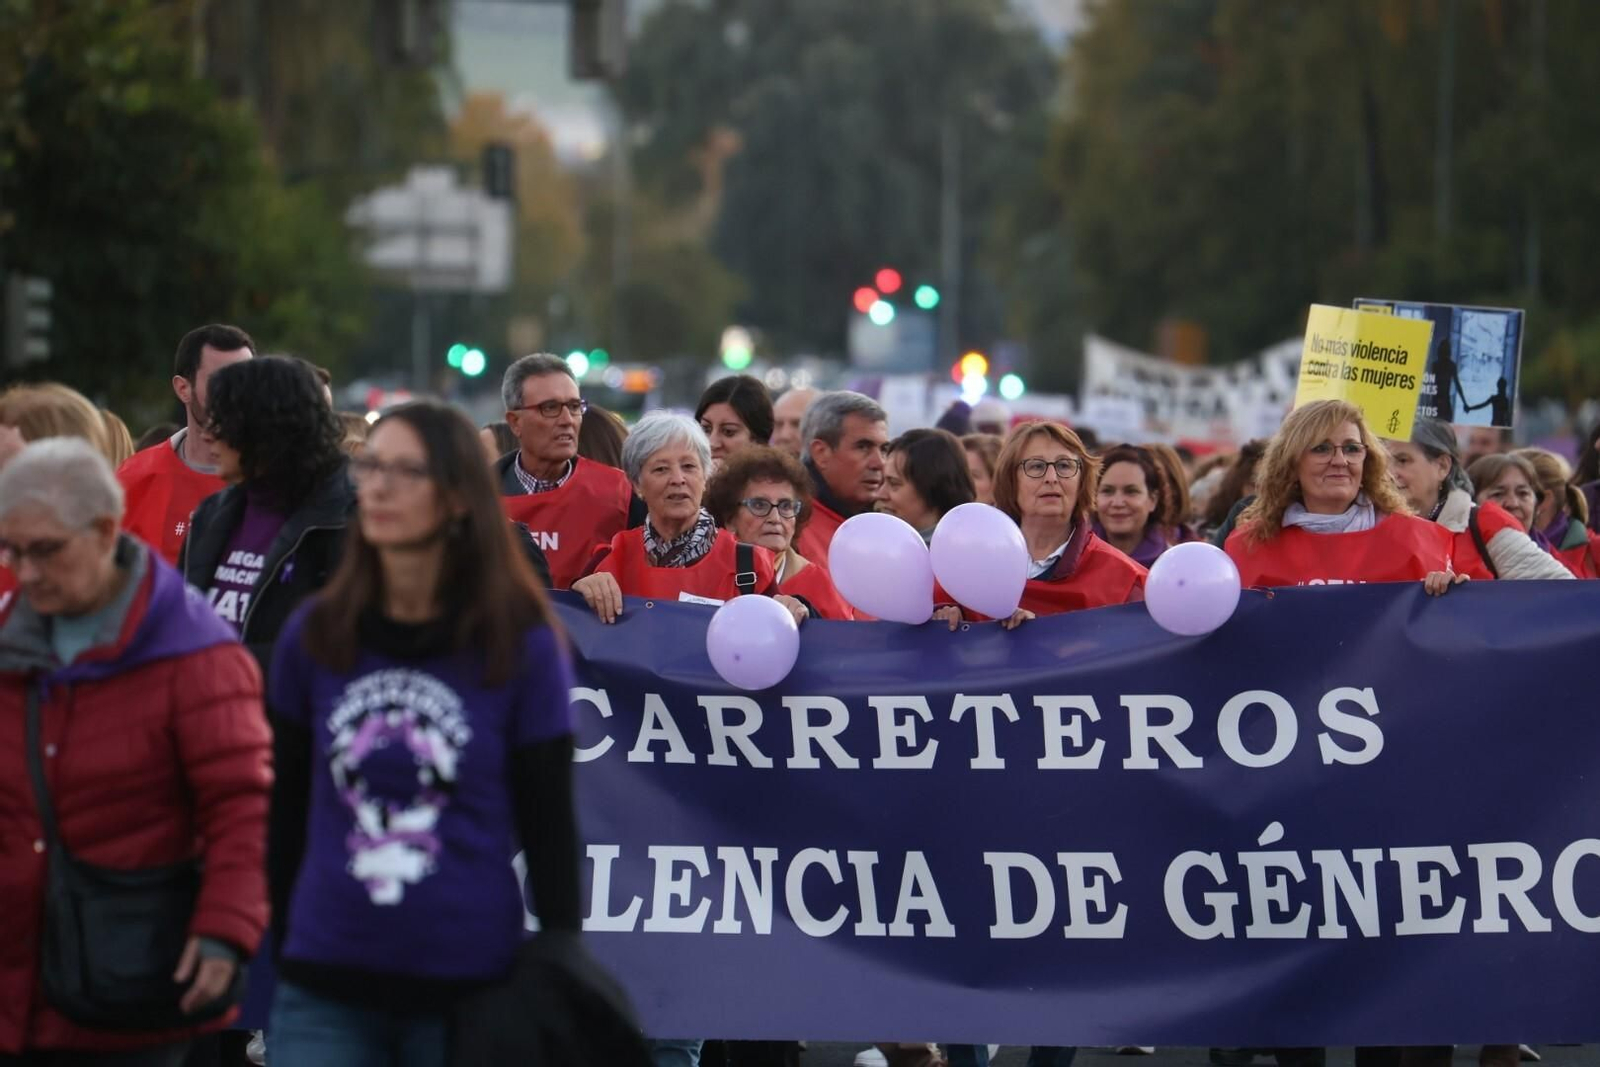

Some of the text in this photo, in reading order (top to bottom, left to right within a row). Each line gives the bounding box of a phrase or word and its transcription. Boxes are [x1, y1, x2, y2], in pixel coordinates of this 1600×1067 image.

[1307, 358, 1339, 378] contra
[1341, 360, 1359, 381] las
[1361, 366, 1416, 390] mujeres
[1311, 332, 1409, 365] No más violencia
[569, 686, 1385, 770] CARRETEROS
[983, 851, 1129, 940] DE
[1163, 821, 1600, 941] GÉNERO
